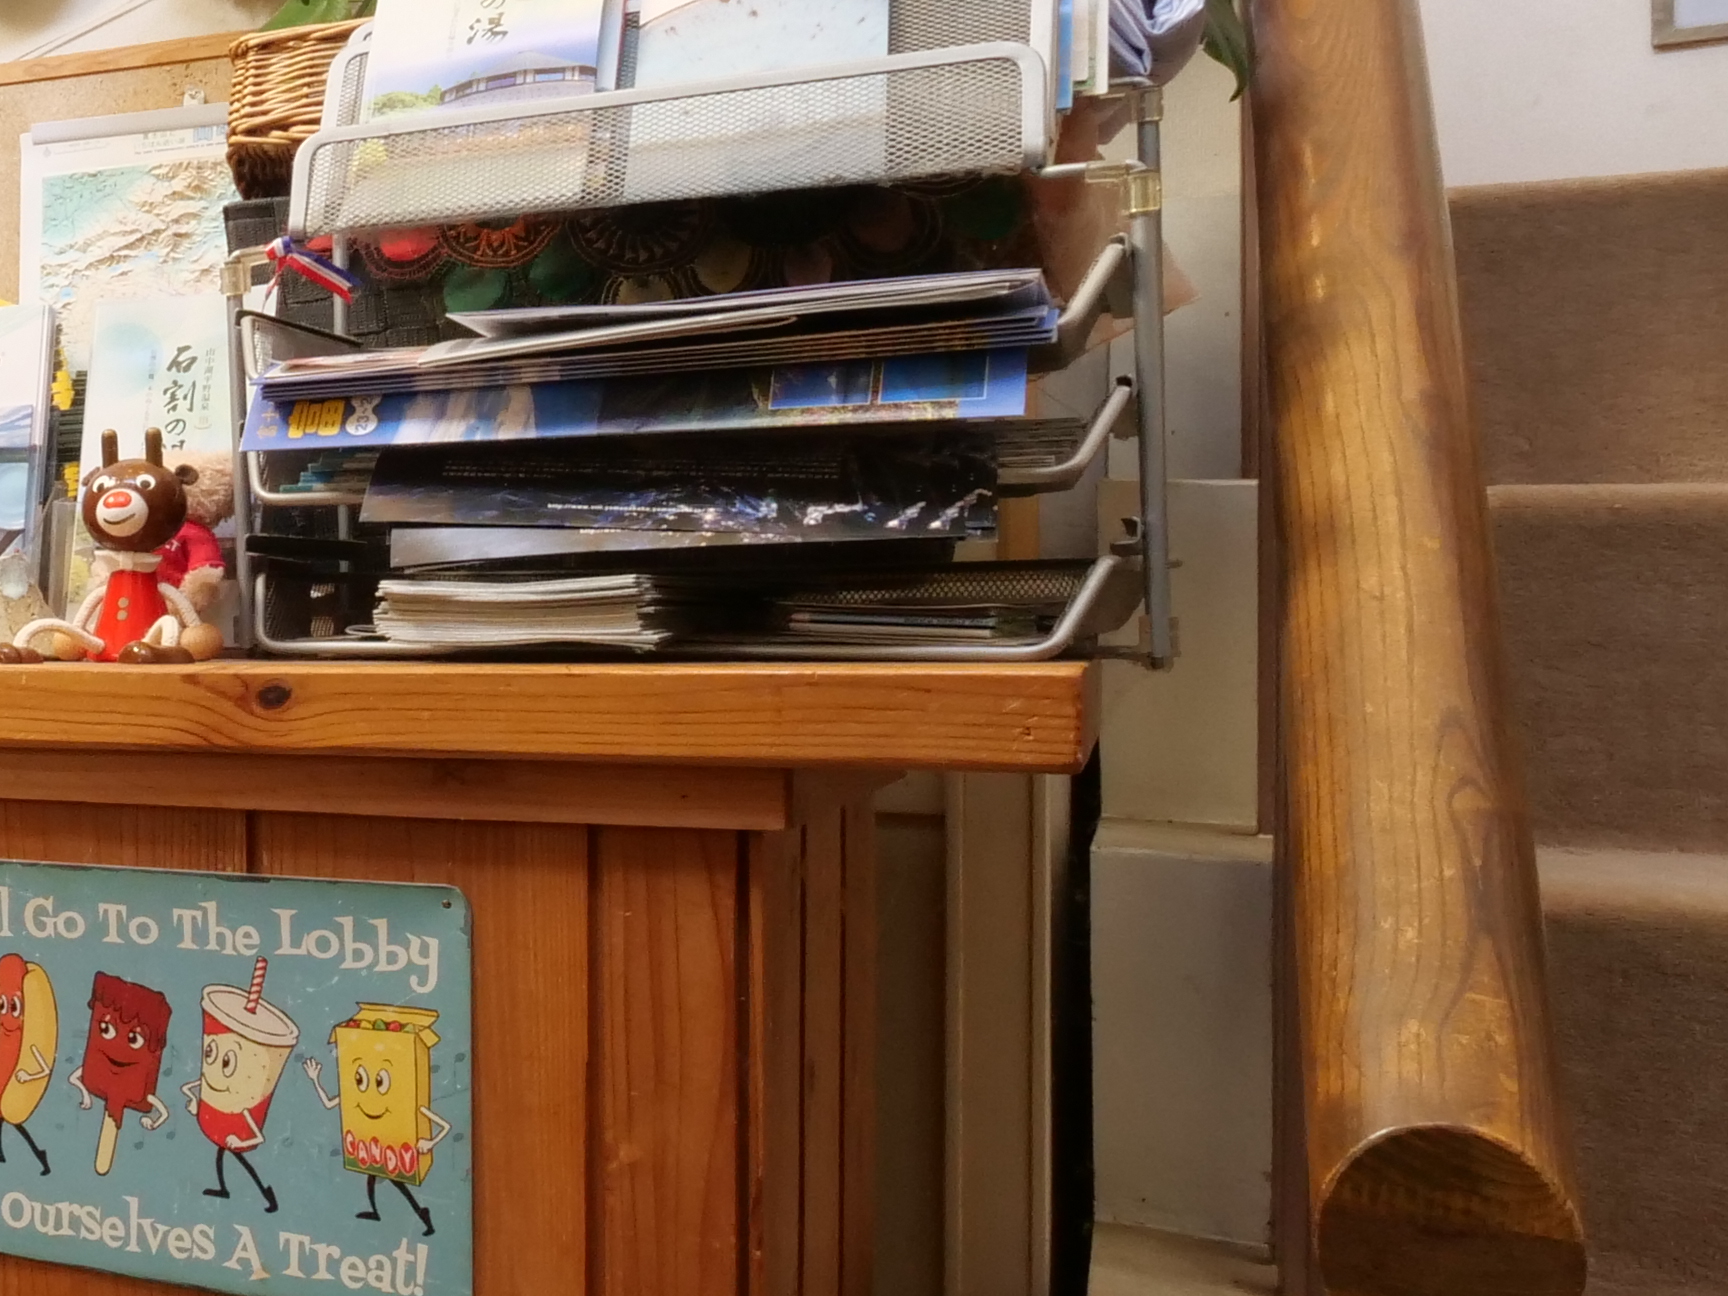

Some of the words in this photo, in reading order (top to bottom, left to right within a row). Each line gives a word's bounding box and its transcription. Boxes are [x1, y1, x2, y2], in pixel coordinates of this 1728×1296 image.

[24, 895, 86, 941] Go
[98, 903, 159, 946] To
[173, 901, 260, 956] The
[274, 908, 440, 994] Lobby
[346, 1131, 414, 1174] CANDY
[1, 1191, 216, 1259] Ourselves
[229, 1224, 271, 1281] A
